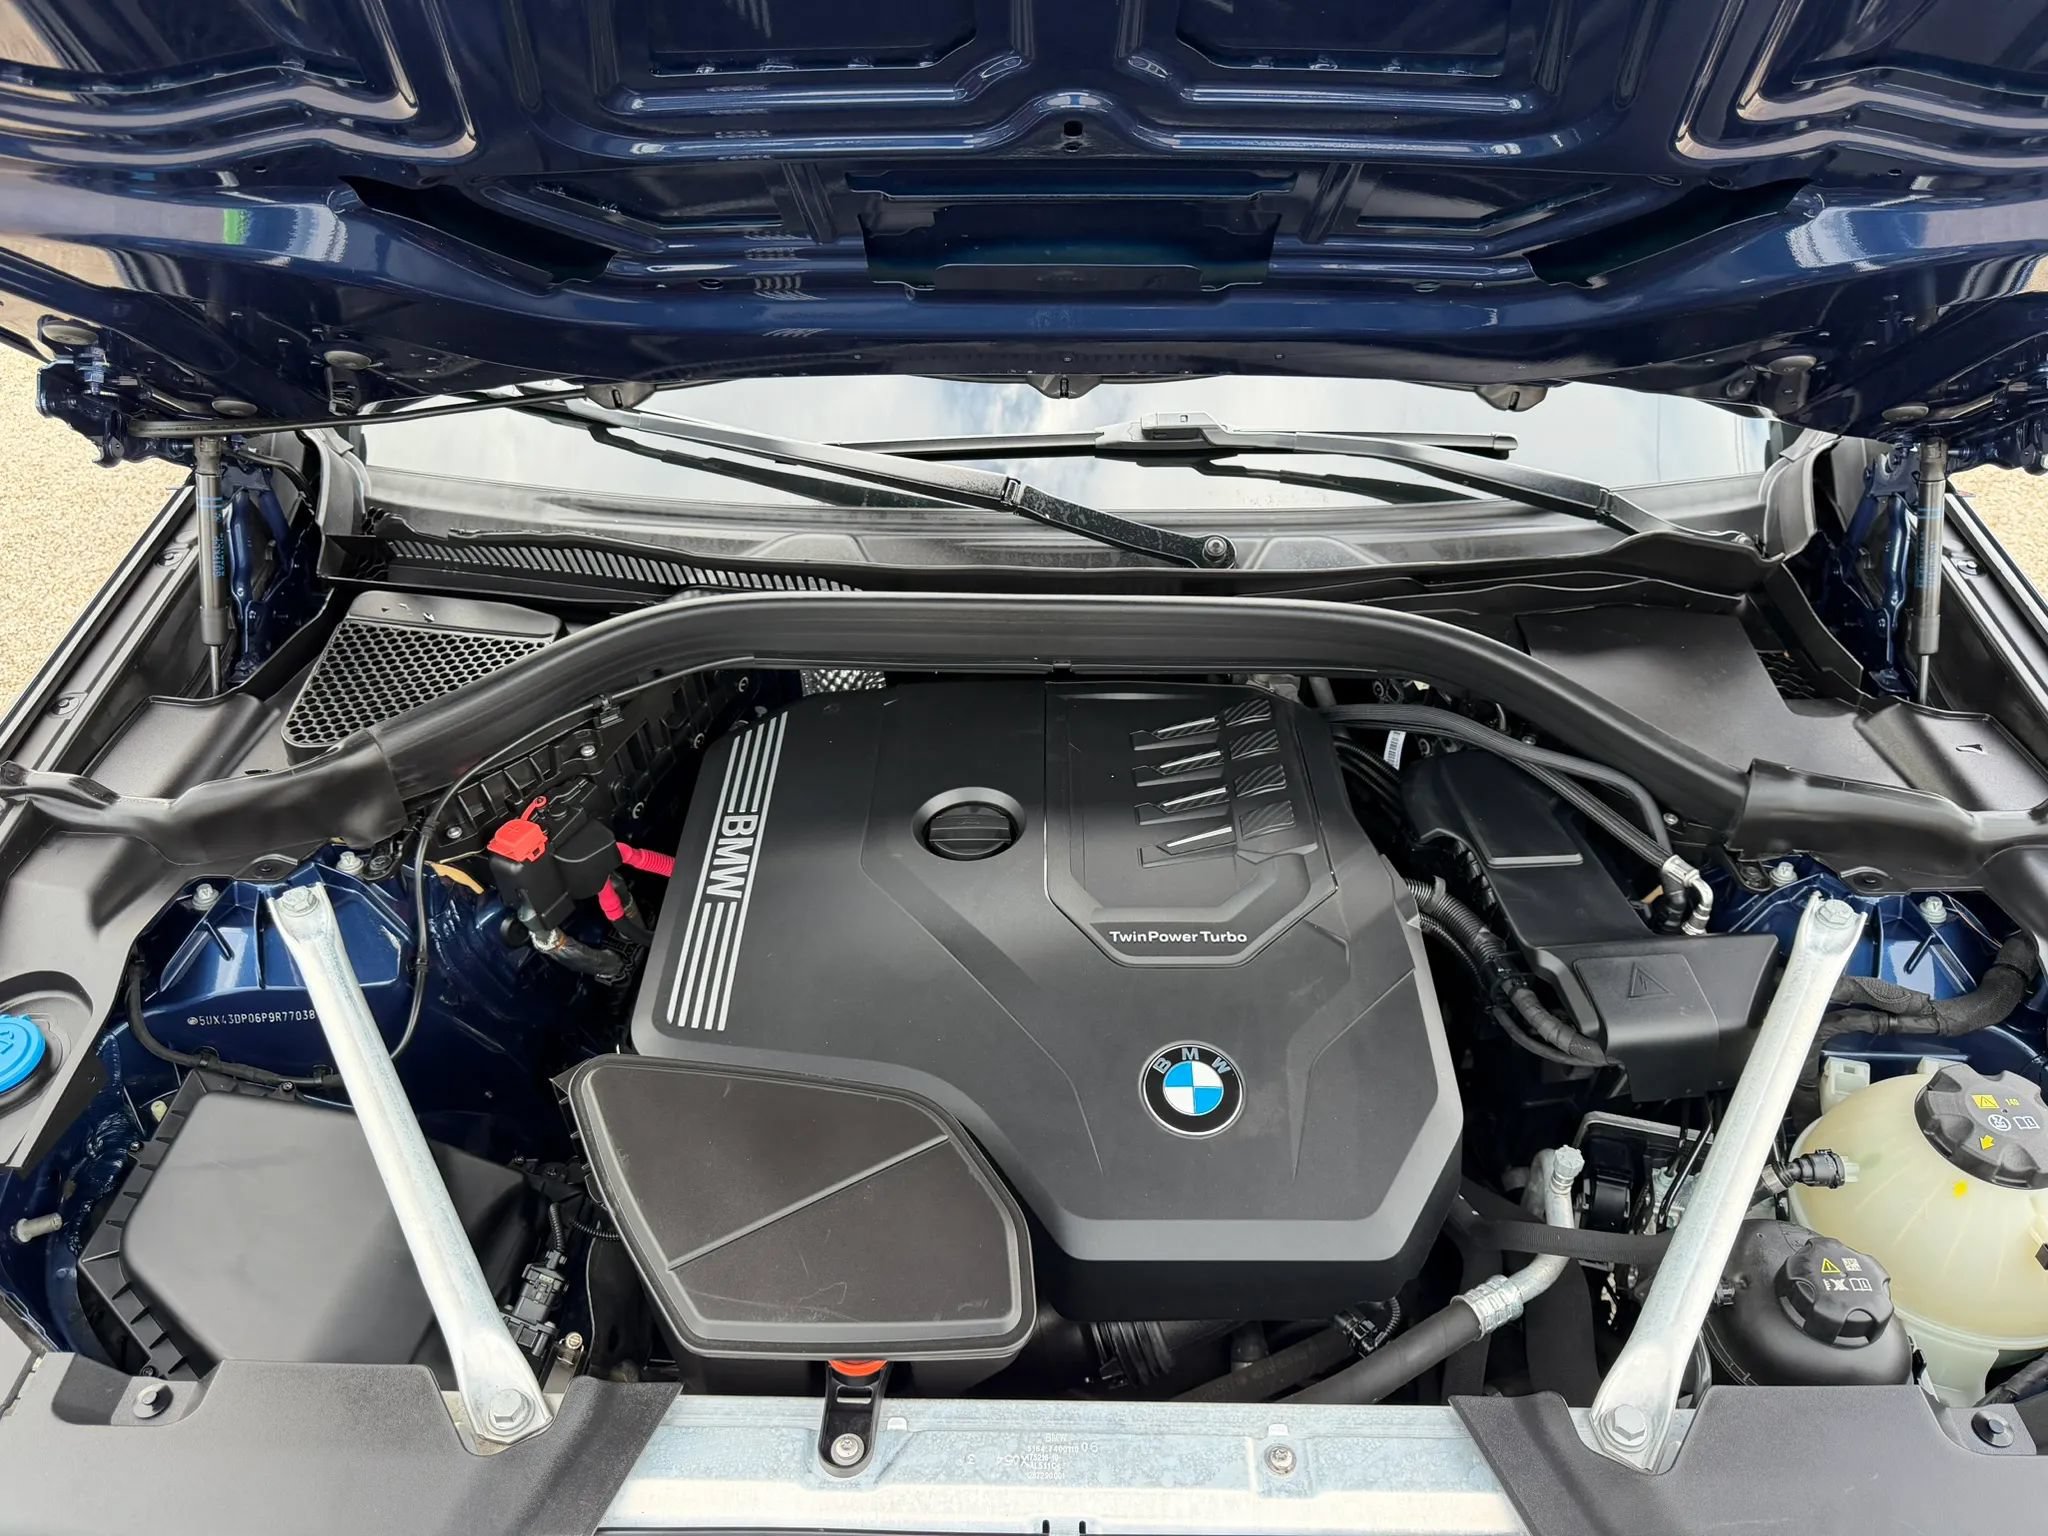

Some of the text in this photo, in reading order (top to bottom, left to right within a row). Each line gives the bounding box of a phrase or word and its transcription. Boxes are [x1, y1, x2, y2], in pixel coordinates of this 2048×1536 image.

[706, 815, 758, 898] BMW
[1109, 931, 1247, 943] TwinPower Turbo
[199, 1009, 316, 1026] 5UX43DP06P9R77038
[1153, 1047, 1232, 1074] BMW
